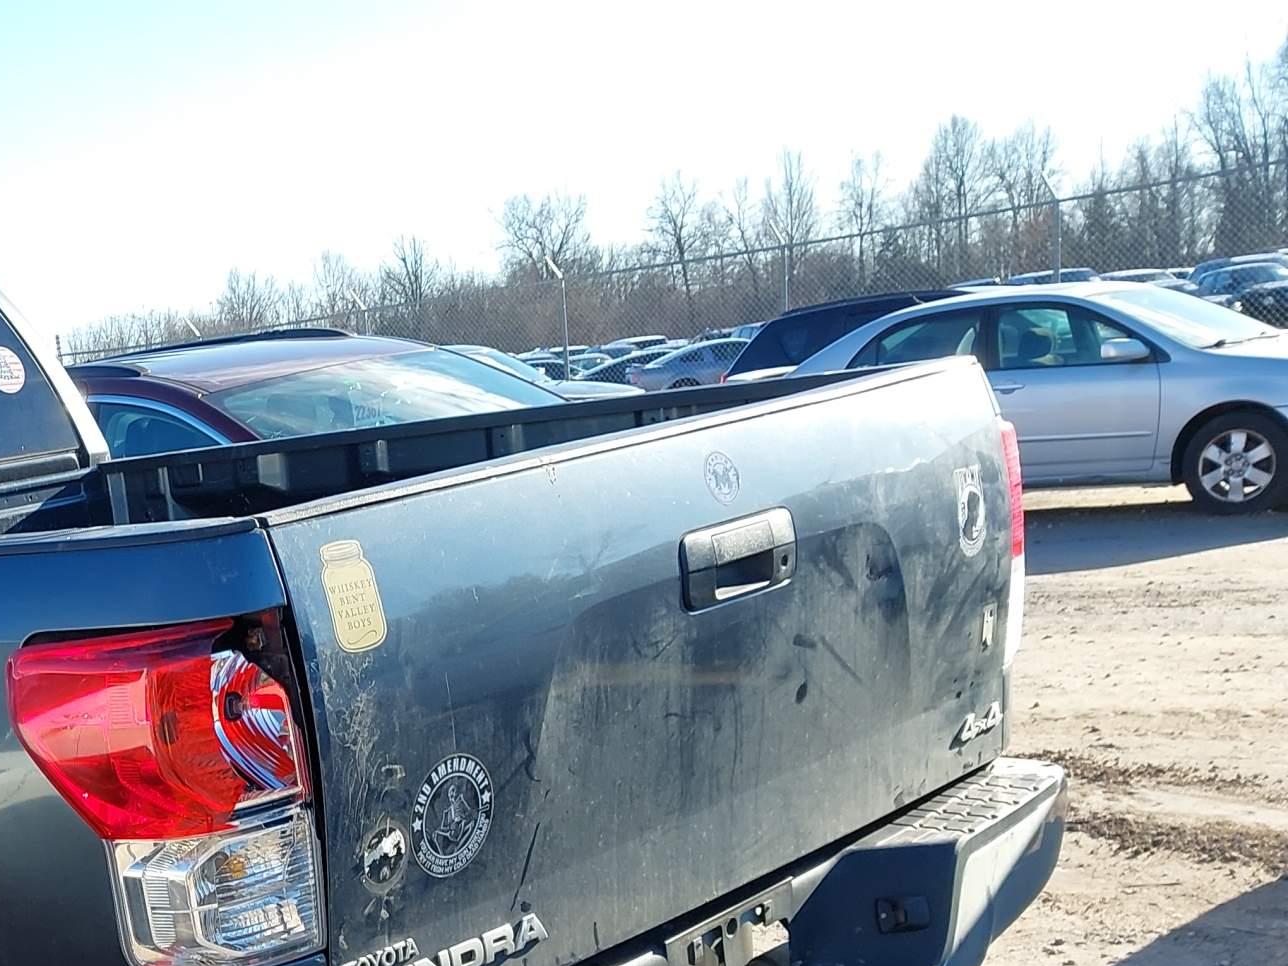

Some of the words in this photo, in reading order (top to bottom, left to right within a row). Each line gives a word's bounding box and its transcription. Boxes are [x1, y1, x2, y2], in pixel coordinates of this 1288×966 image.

[329, 578, 372, 594] WHISKEY
[339, 592, 366, 606] BENT
[337, 603, 375, 619] VALLEY
[347, 617, 372, 630] BOYS
[415, 783, 432, 814] 2ND
[431, 757, 489, 790] AMENDMENT
[453, 857, 467, 870] COLD
